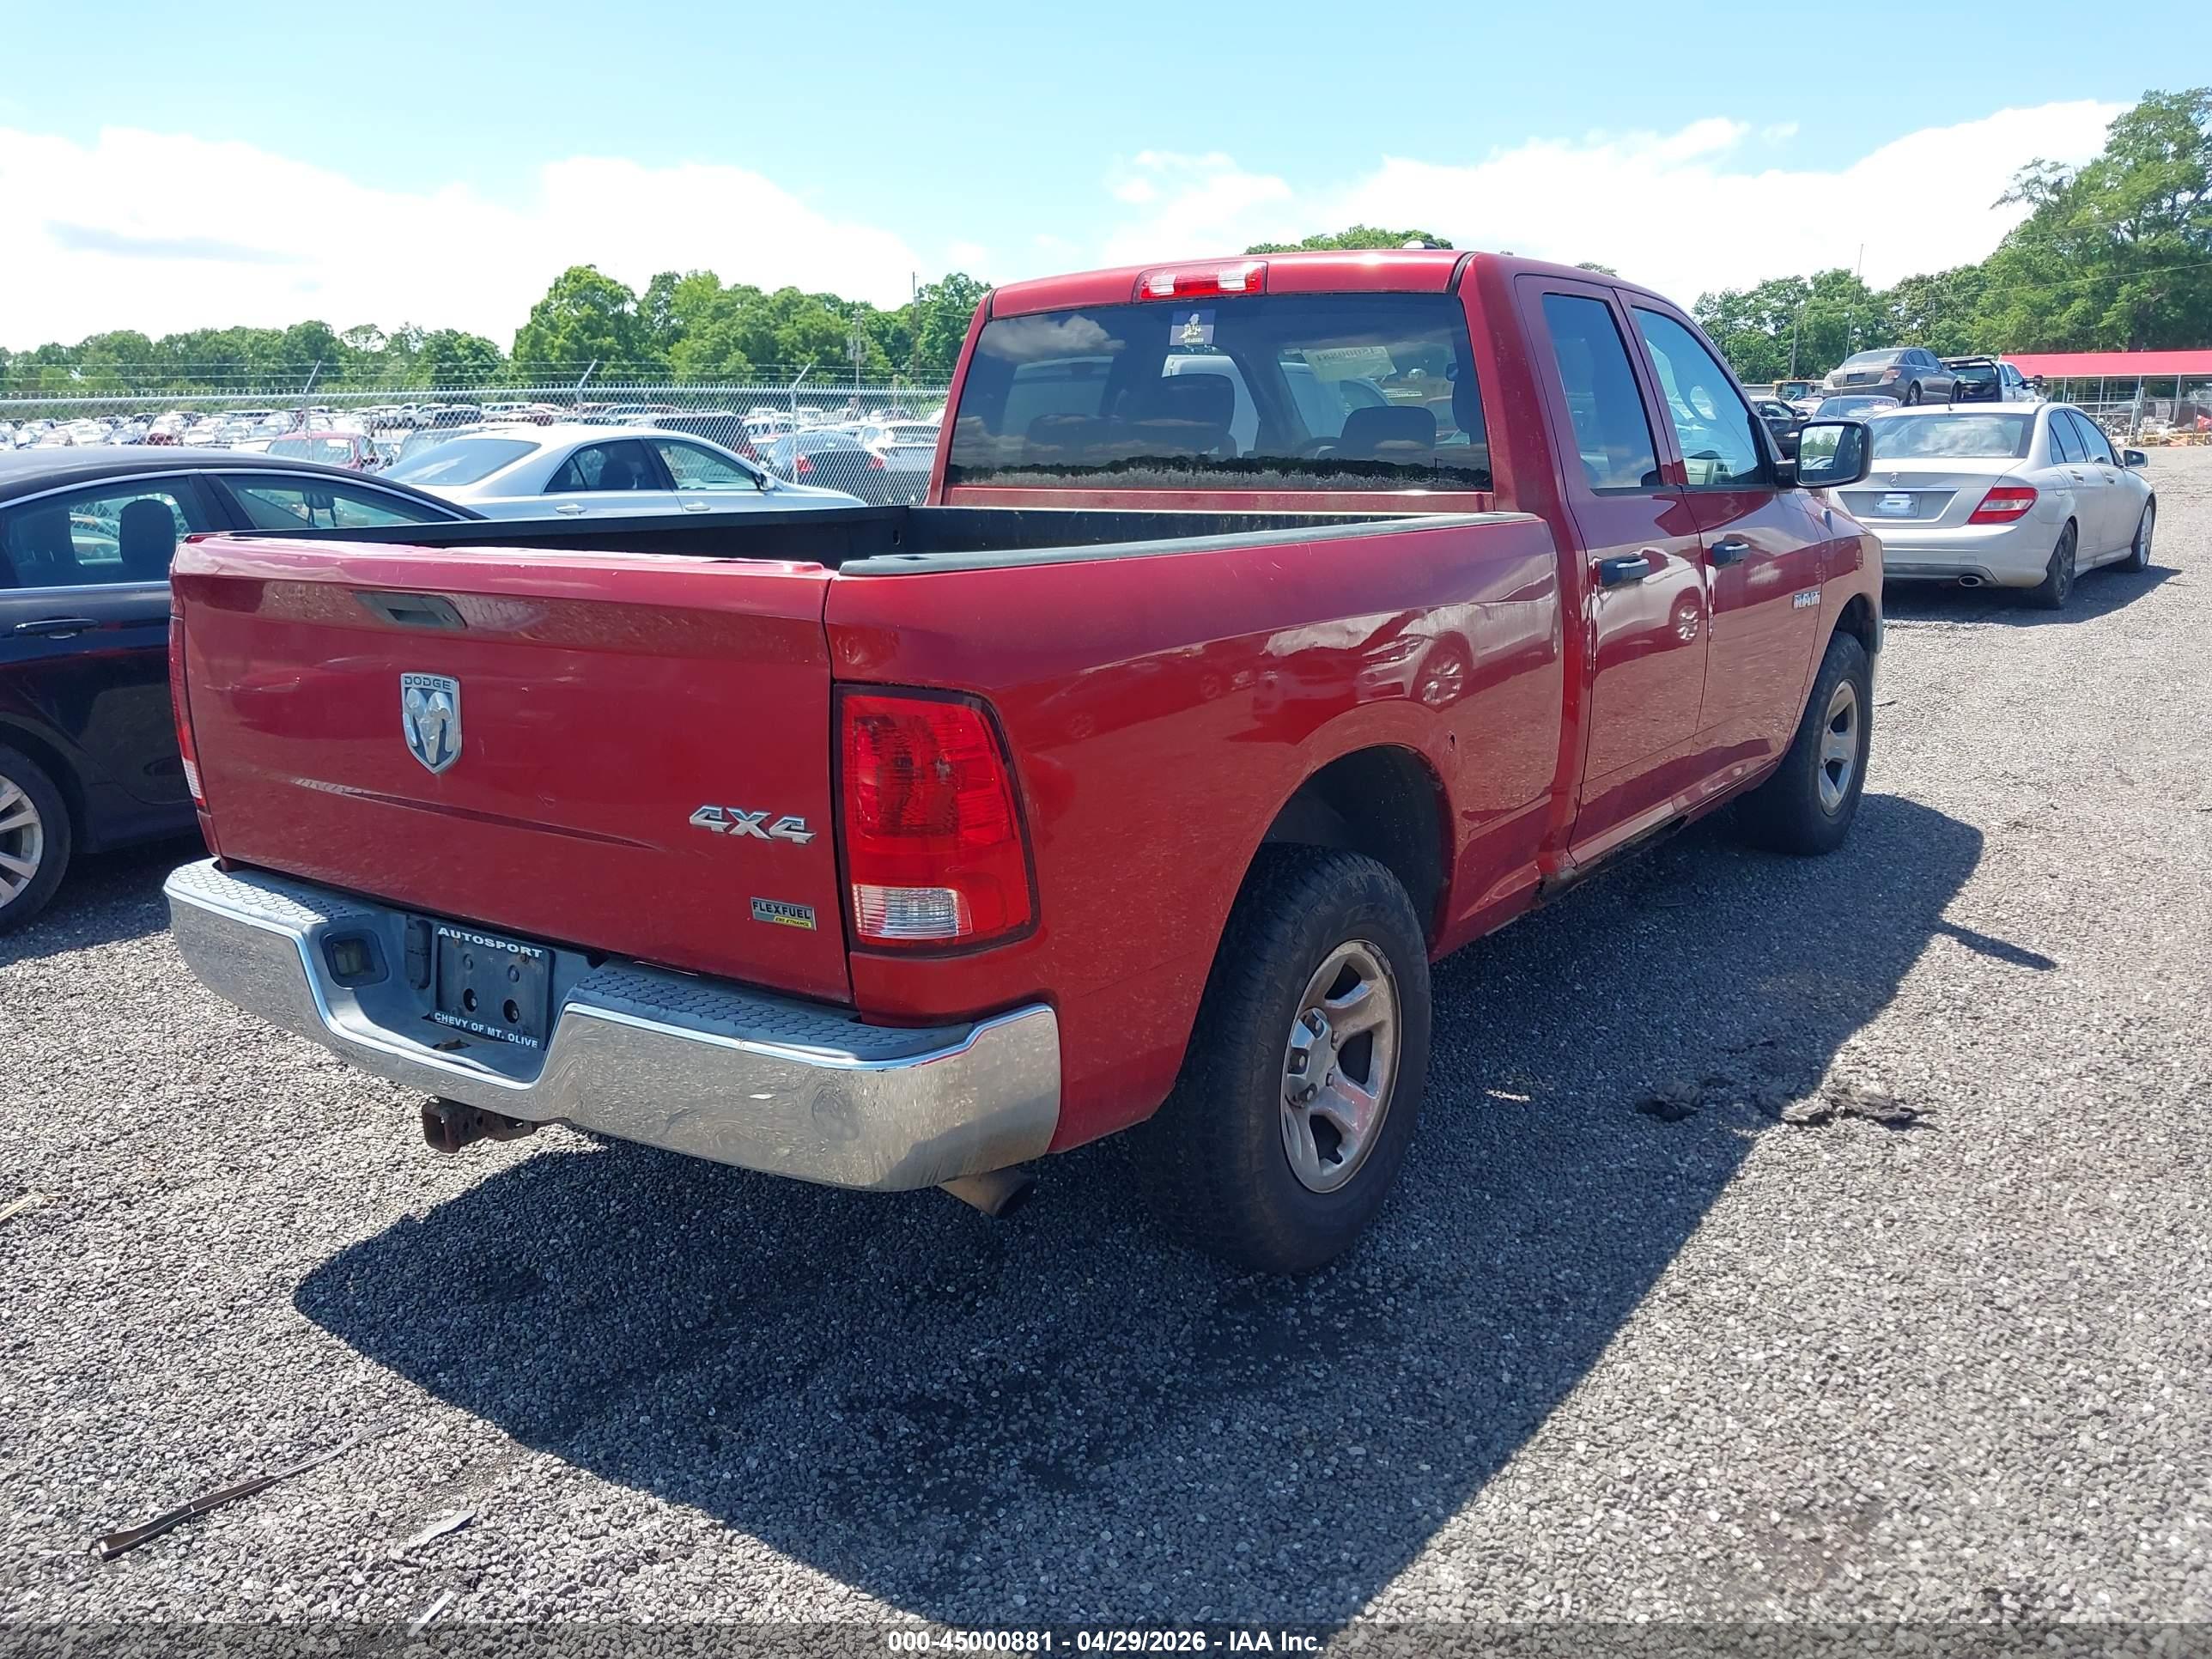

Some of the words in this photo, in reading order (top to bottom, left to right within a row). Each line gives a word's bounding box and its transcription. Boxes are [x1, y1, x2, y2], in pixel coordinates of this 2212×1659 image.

[404, 676, 452, 690] DODGE
[752, 902, 811, 920] FLEXFUEL
[437, 927, 543, 958] AUTOSPORT
[434, 1012, 469, 1029] CHEVY
[471, 1022, 485, 1033] OF
[487, 1026, 505, 1040] MT.
[507, 1032, 539, 1048] OLIVE
